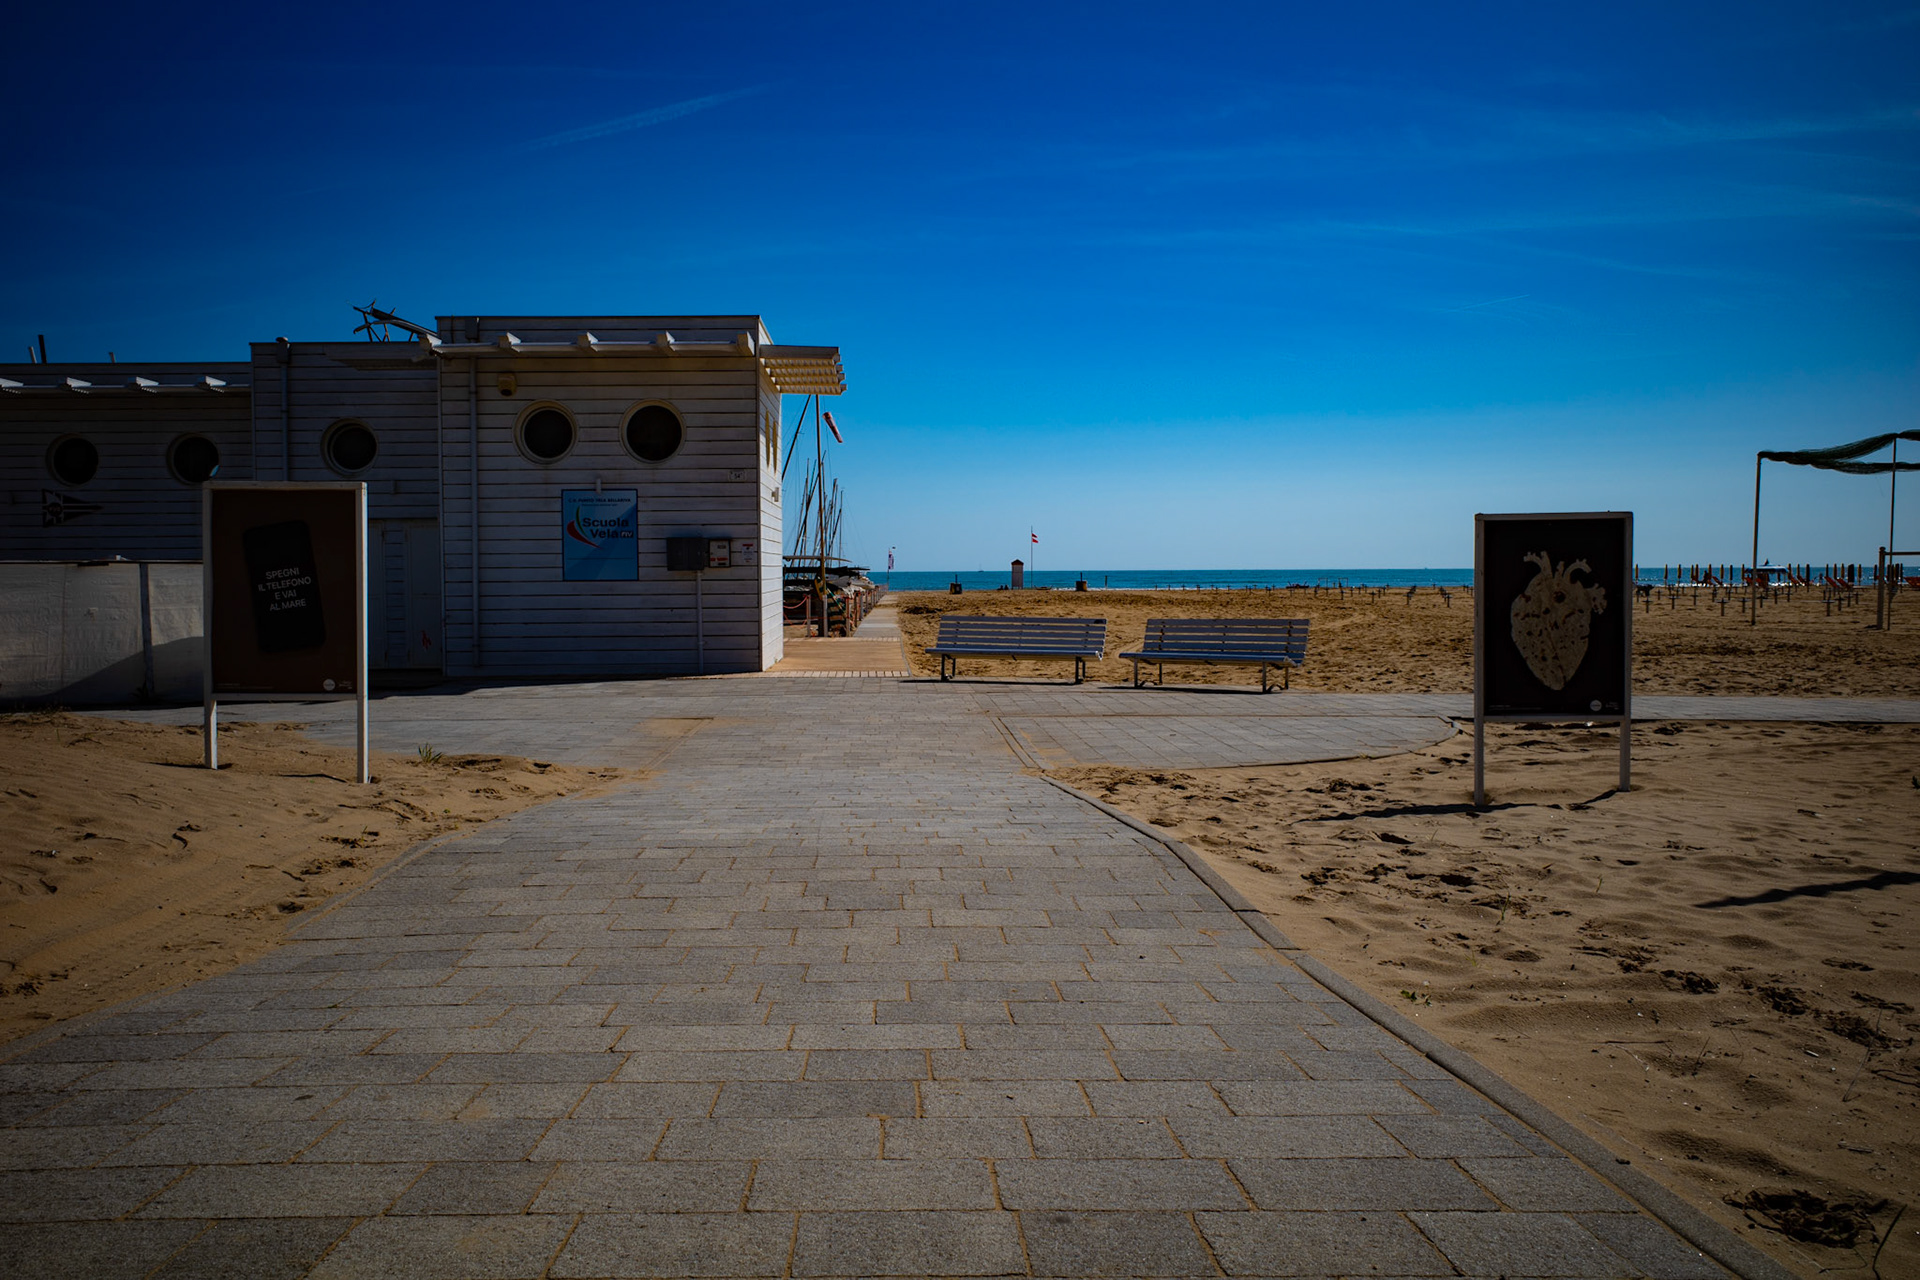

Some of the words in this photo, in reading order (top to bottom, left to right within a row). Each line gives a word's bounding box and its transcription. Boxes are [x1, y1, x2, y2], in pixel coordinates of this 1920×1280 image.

[583, 517, 629, 527] Scuola
[590, 529, 618, 538] Vela
[265, 567, 300, 579] SPEGNI
[257, 583, 266, 592] IL
[265, 576, 311, 590] TELEFONO
[274, 591, 281, 600] E
[281, 589, 297, 599] VAI
[269, 602, 281, 612] AL
[281, 598, 307, 609] MARE
